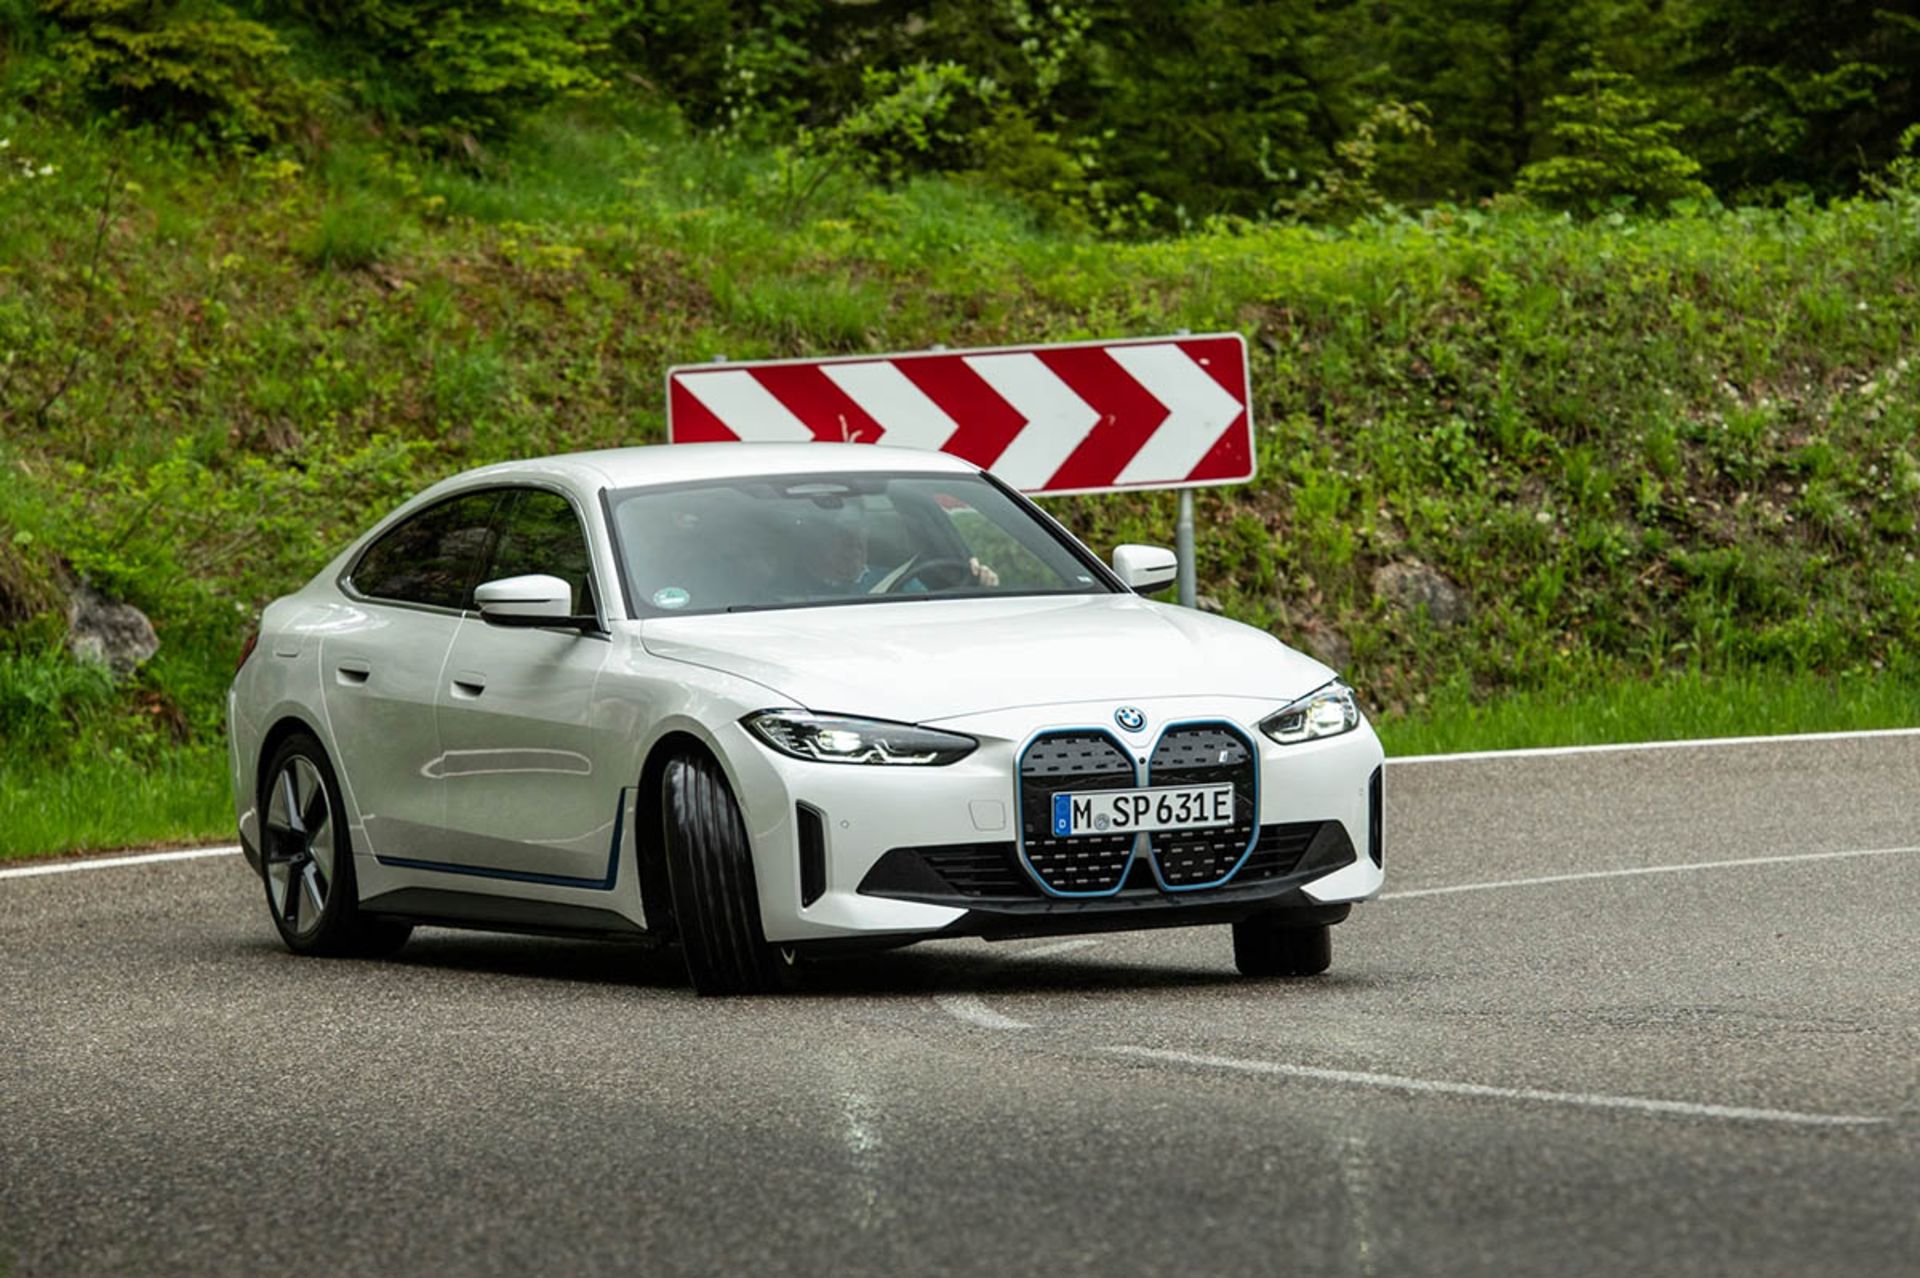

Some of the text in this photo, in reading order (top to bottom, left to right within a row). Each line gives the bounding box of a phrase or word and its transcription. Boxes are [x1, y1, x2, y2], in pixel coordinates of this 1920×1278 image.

[1073, 788, 1231, 829] M SP 631E
